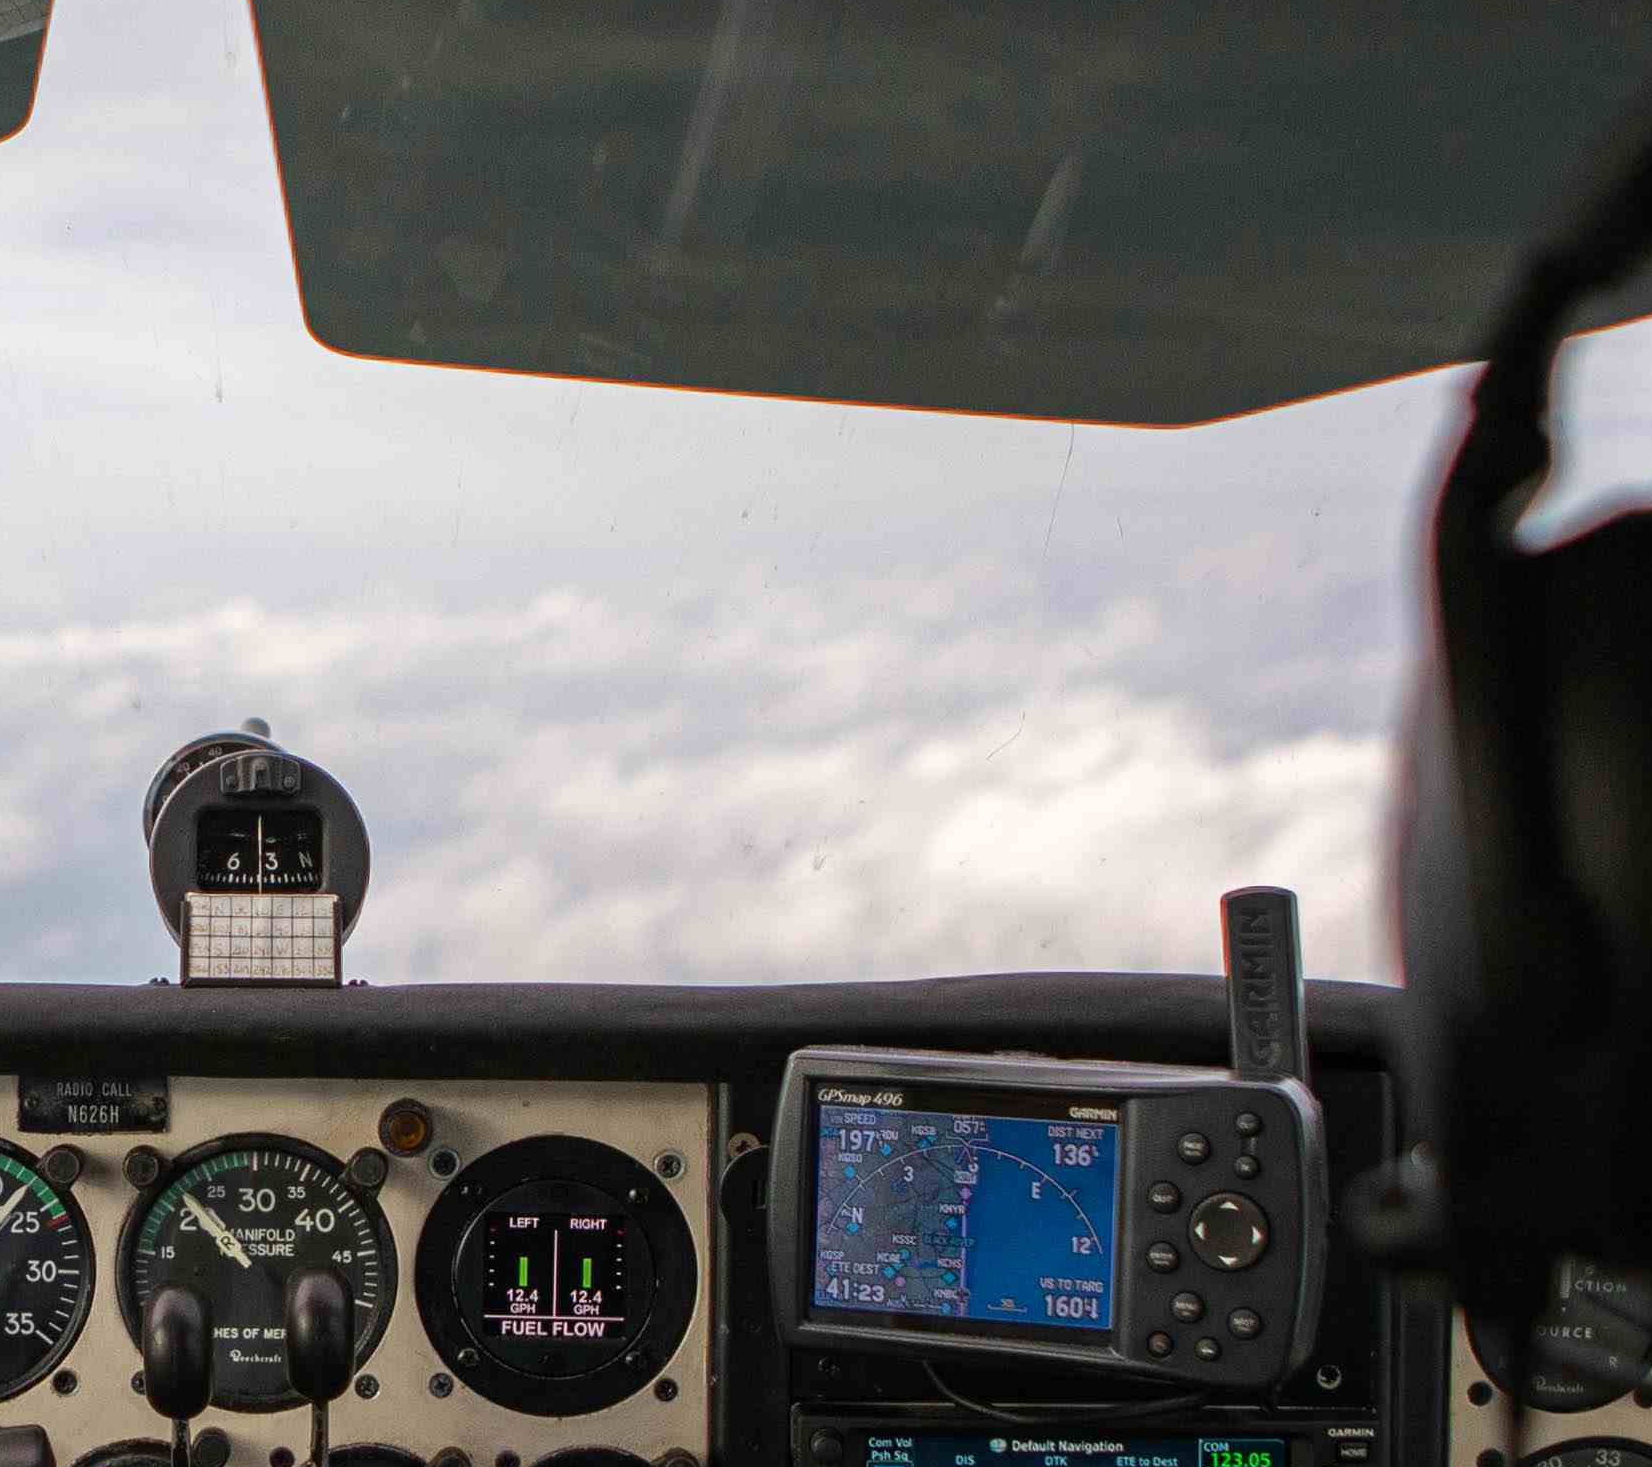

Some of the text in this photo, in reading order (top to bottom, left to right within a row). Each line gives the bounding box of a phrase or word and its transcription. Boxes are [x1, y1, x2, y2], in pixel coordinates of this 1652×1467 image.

[227, 852, 313, 870] 6 3 N
[57, 1083, 132, 1096] RADIO CALL
[818, 1089, 902, 1106] GPSmap 496
[68, 1105, 119, 1123] N626H
[207, 1186, 225, 1198] 25
[287, 1187, 306, 1199] 35
[239, 1189, 275, 1212] 30
[11, 1211, 40, 1233] 25
[295, 1209, 334, 1232] 40
[509, 1218, 539, 1227] LEFT
[570, 1219, 607, 1229] RIGHT
[332, 1250, 352, 1263] 45
[26, 1261, 56, 1282] 30
[507, 1289, 538, 1302] 12.4
[570, 1290, 602, 1303] 12.4
[510, 1304, 535, 1313] GPH
[574, 1305, 599, 1315] GPH
[5, 1313, 34, 1334] 35
[502, 1321, 604, 1336] FUEL FLOW
[1012, 1441, 1123, 1453] Default Navigation
[956, 1456, 975, 1465] DIS
[1045, 1456, 1067, 1465] DTK
[1117, 1457, 1178, 1467] ETE to Dest
[1211, 1453, 1271, 1467] 123.05
